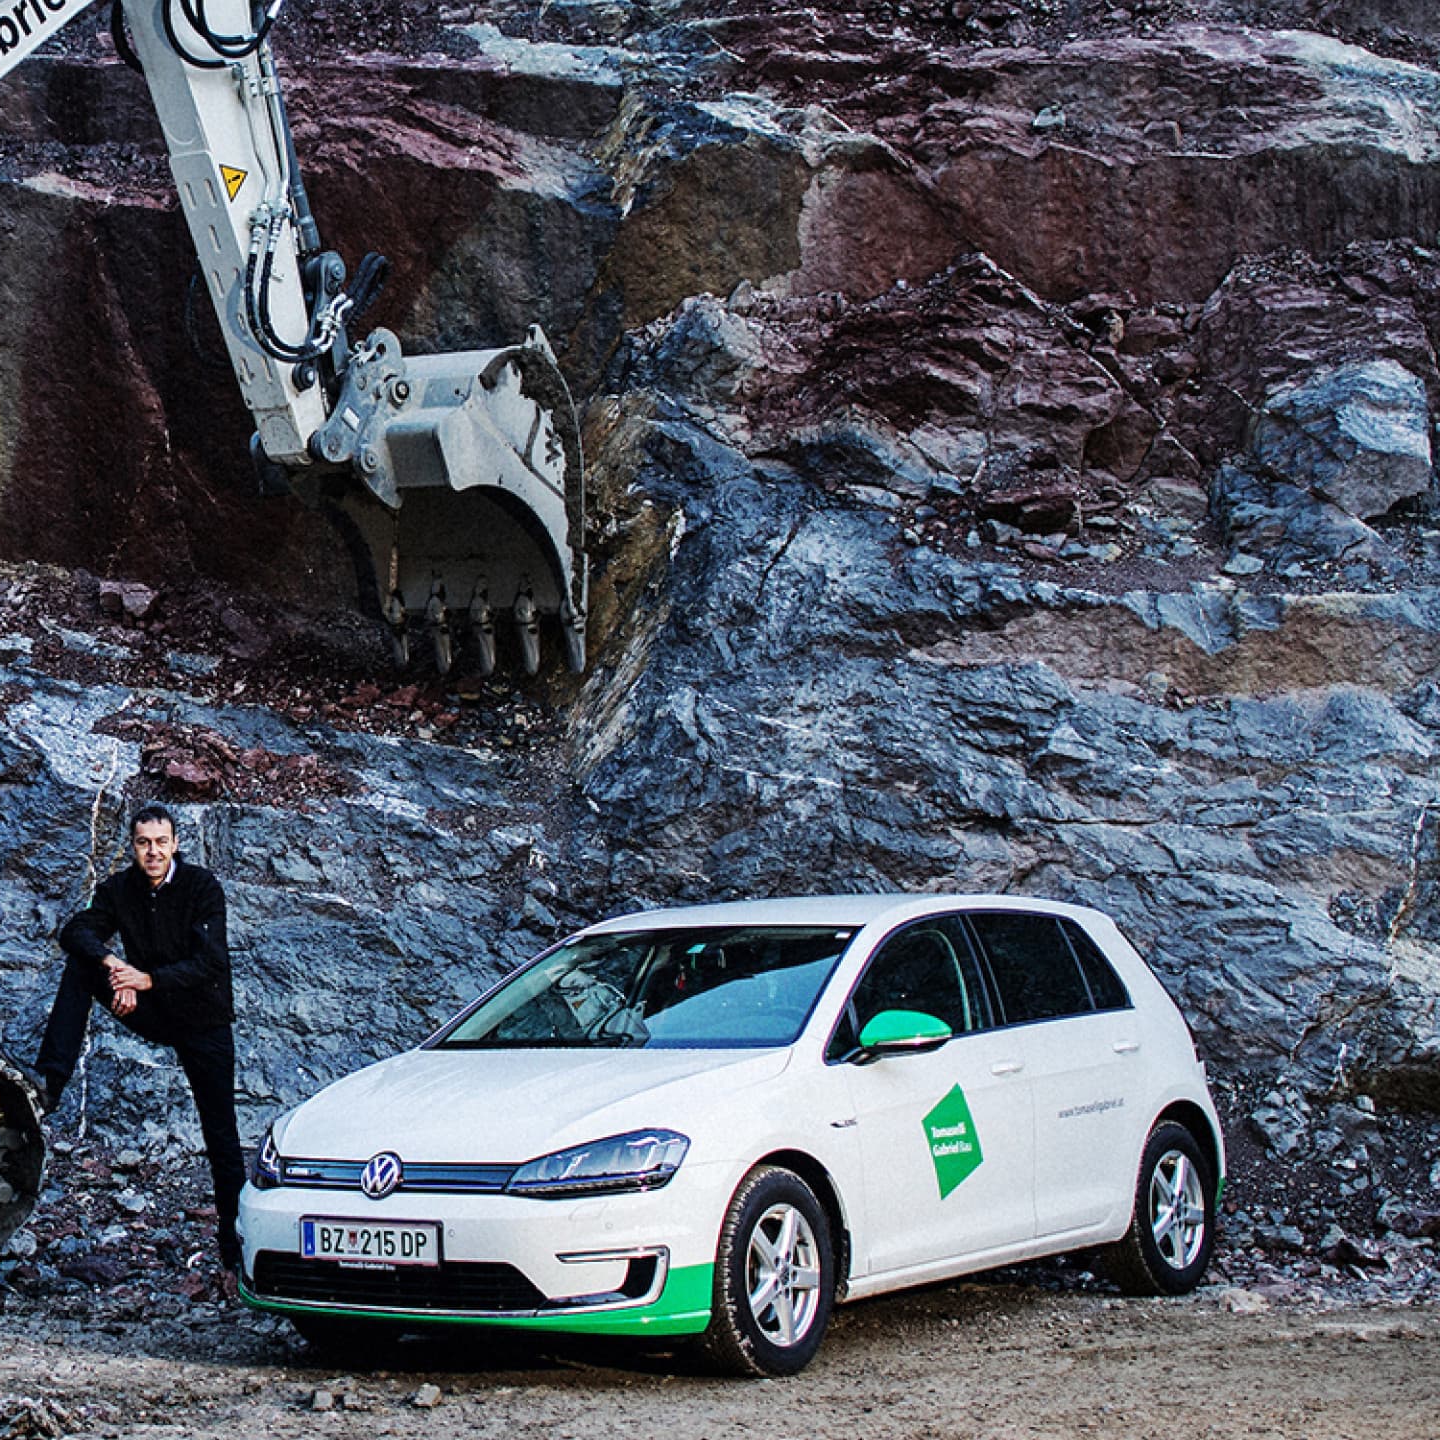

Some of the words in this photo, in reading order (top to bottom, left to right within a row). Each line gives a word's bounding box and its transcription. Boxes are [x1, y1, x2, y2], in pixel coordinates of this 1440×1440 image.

[930, 1121, 967, 1138] Tomaselli
[932, 1140, 959, 1157] Gabriel
[320, 1226, 345, 1254] BZ
[360, 1229, 396, 1257] 215
[401, 1231, 427, 1258] DP
